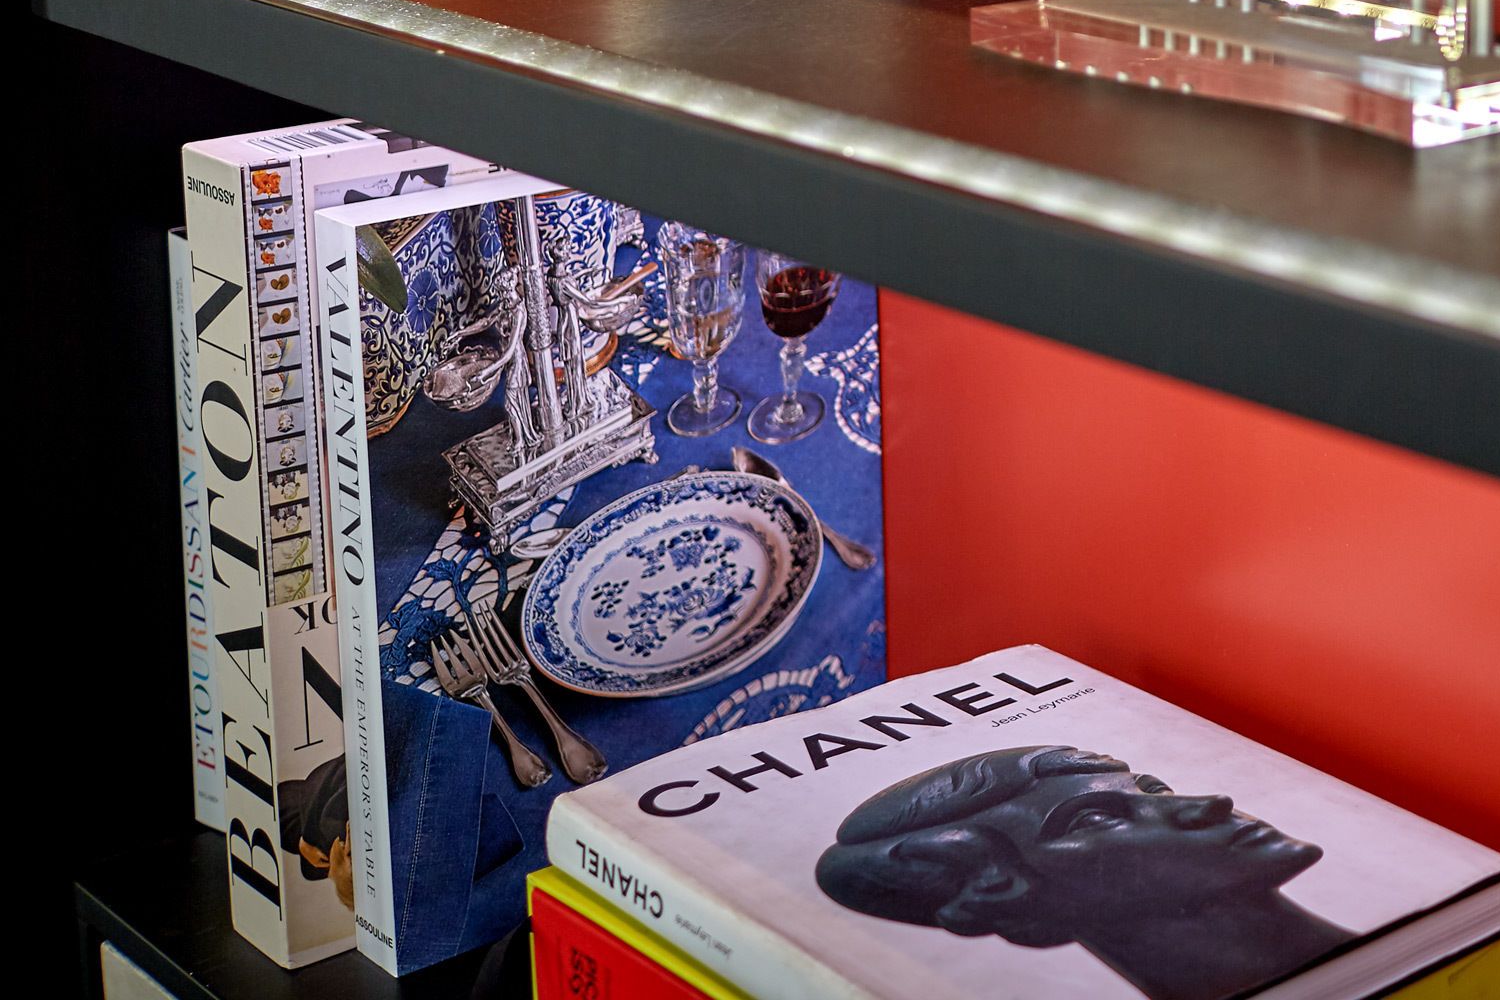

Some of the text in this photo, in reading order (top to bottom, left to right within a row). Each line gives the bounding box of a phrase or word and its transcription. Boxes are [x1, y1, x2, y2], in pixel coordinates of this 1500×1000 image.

[187, 175, 236, 207] ASSOULINE
[176, 327, 196, 433] Cartier
[181, 440, 218, 772] ETOURDISSANT
[190, 249, 282, 922] BEATON
[325, 251, 378, 899] VALENTINO AT THE EMPEROR'S TABLE
[637, 672, 1074, 818] CHANEL
[990, 685, 1097, 730] Jean Leymarie
[355, 914, 393, 950] ASSOULINE
[575, 839, 664, 919] CHANEL
